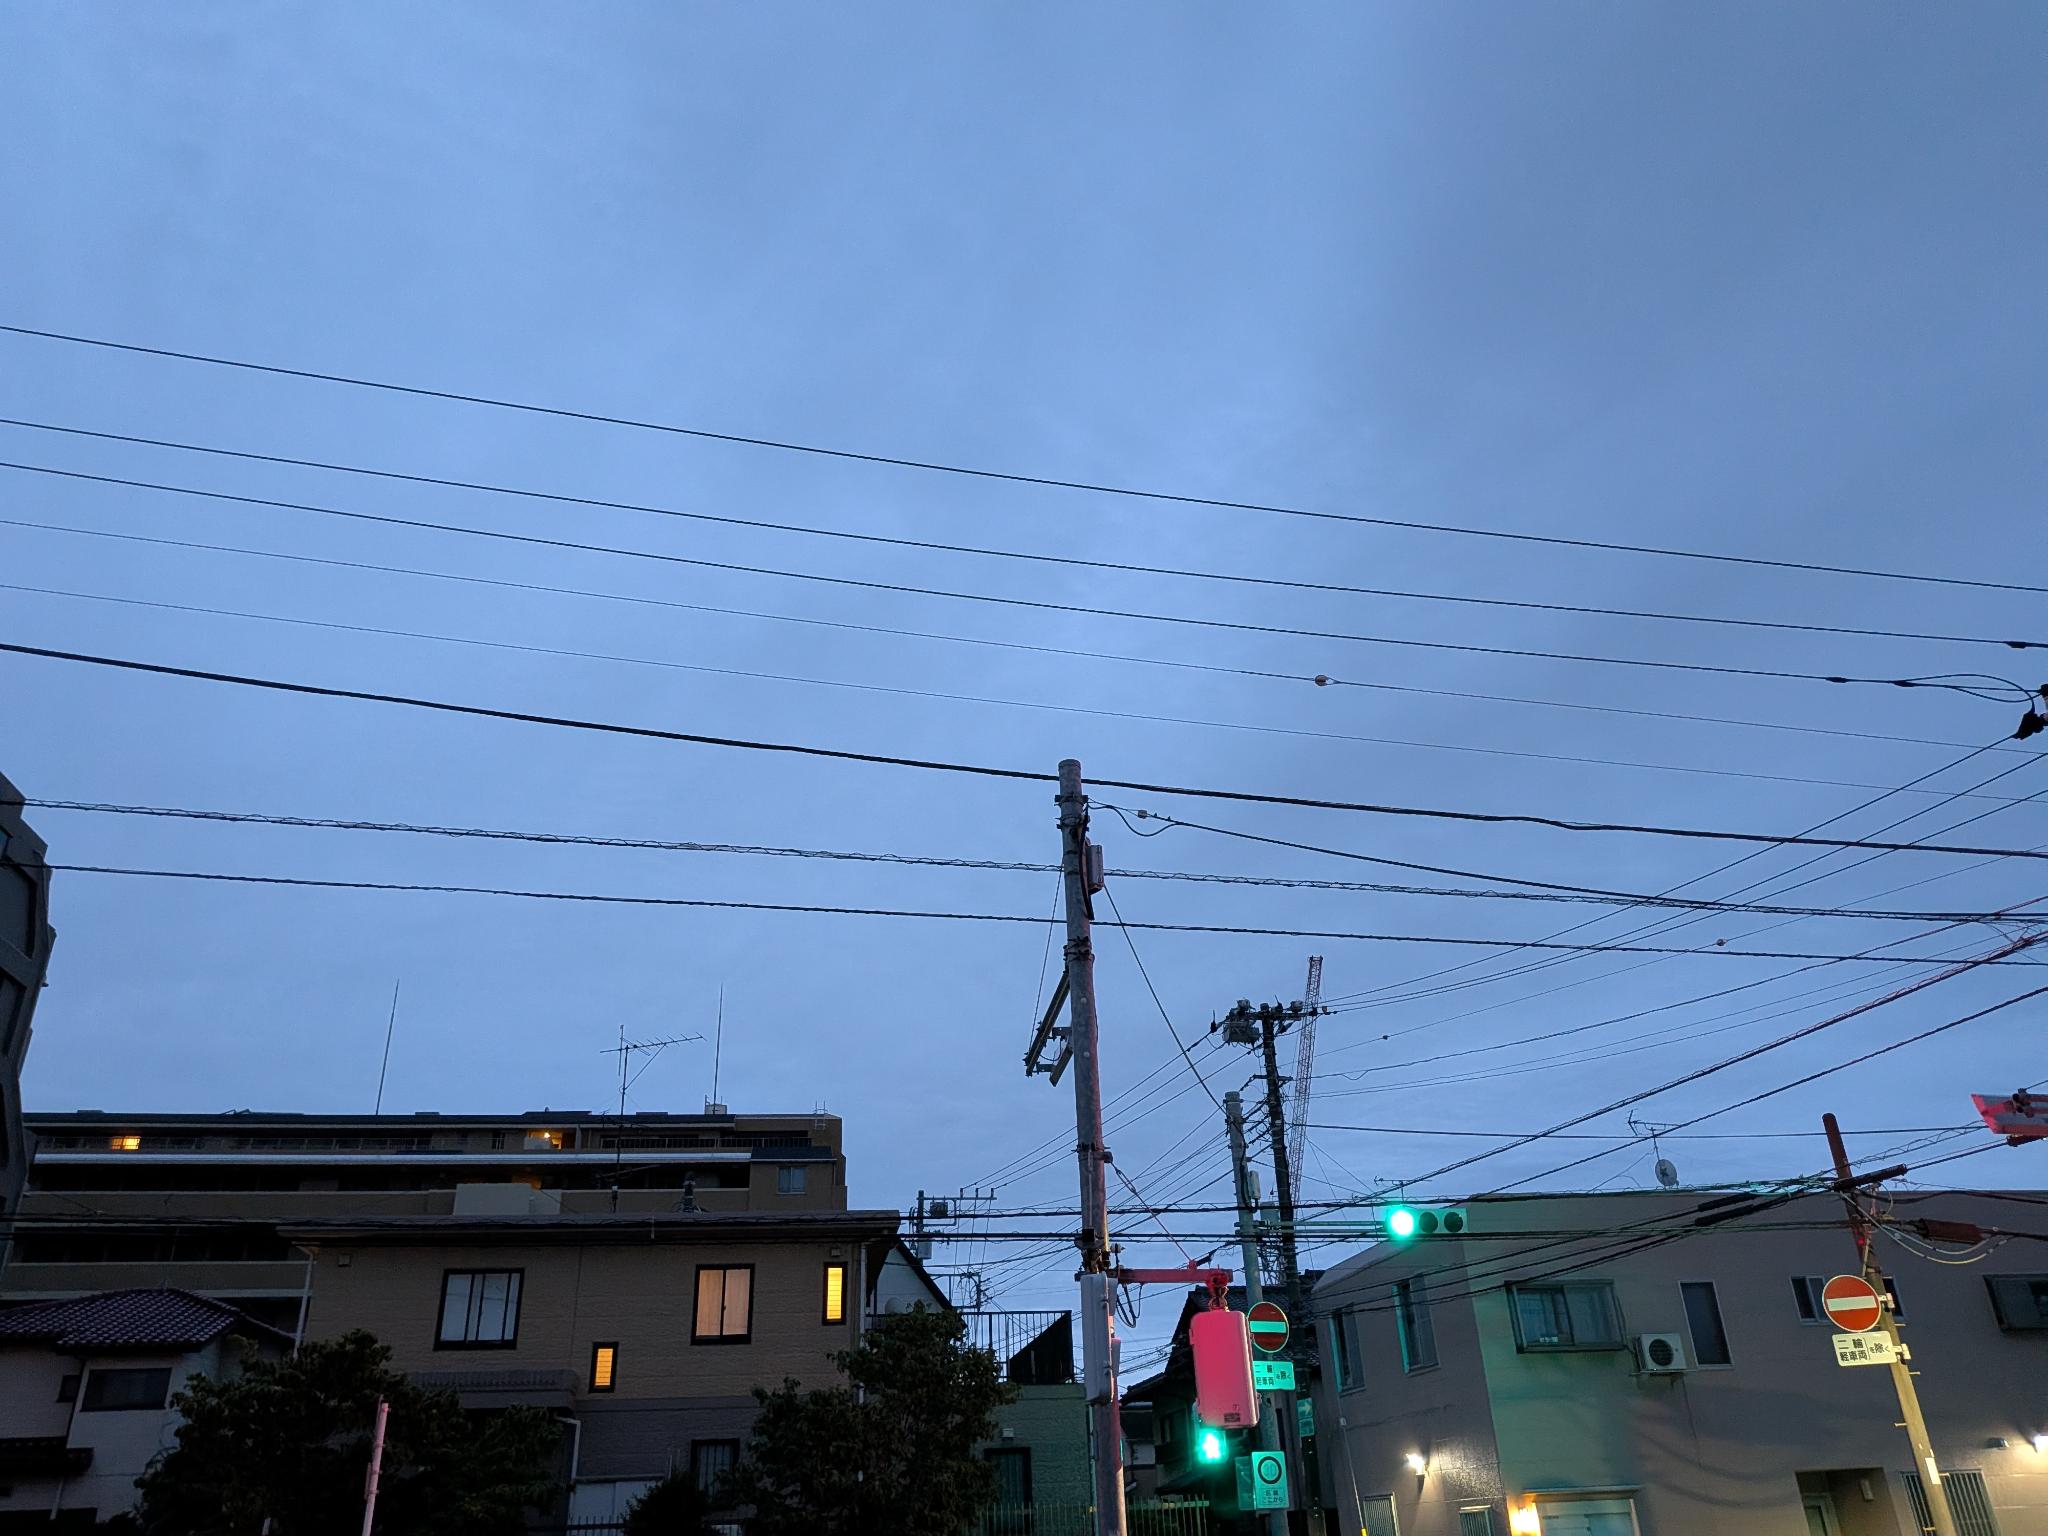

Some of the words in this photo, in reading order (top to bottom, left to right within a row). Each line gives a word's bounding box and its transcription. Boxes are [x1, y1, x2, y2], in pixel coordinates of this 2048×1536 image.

[1838, 1338, 1863, 1349] 二輪
[1840, 1350, 1868, 1361] 軽車両
